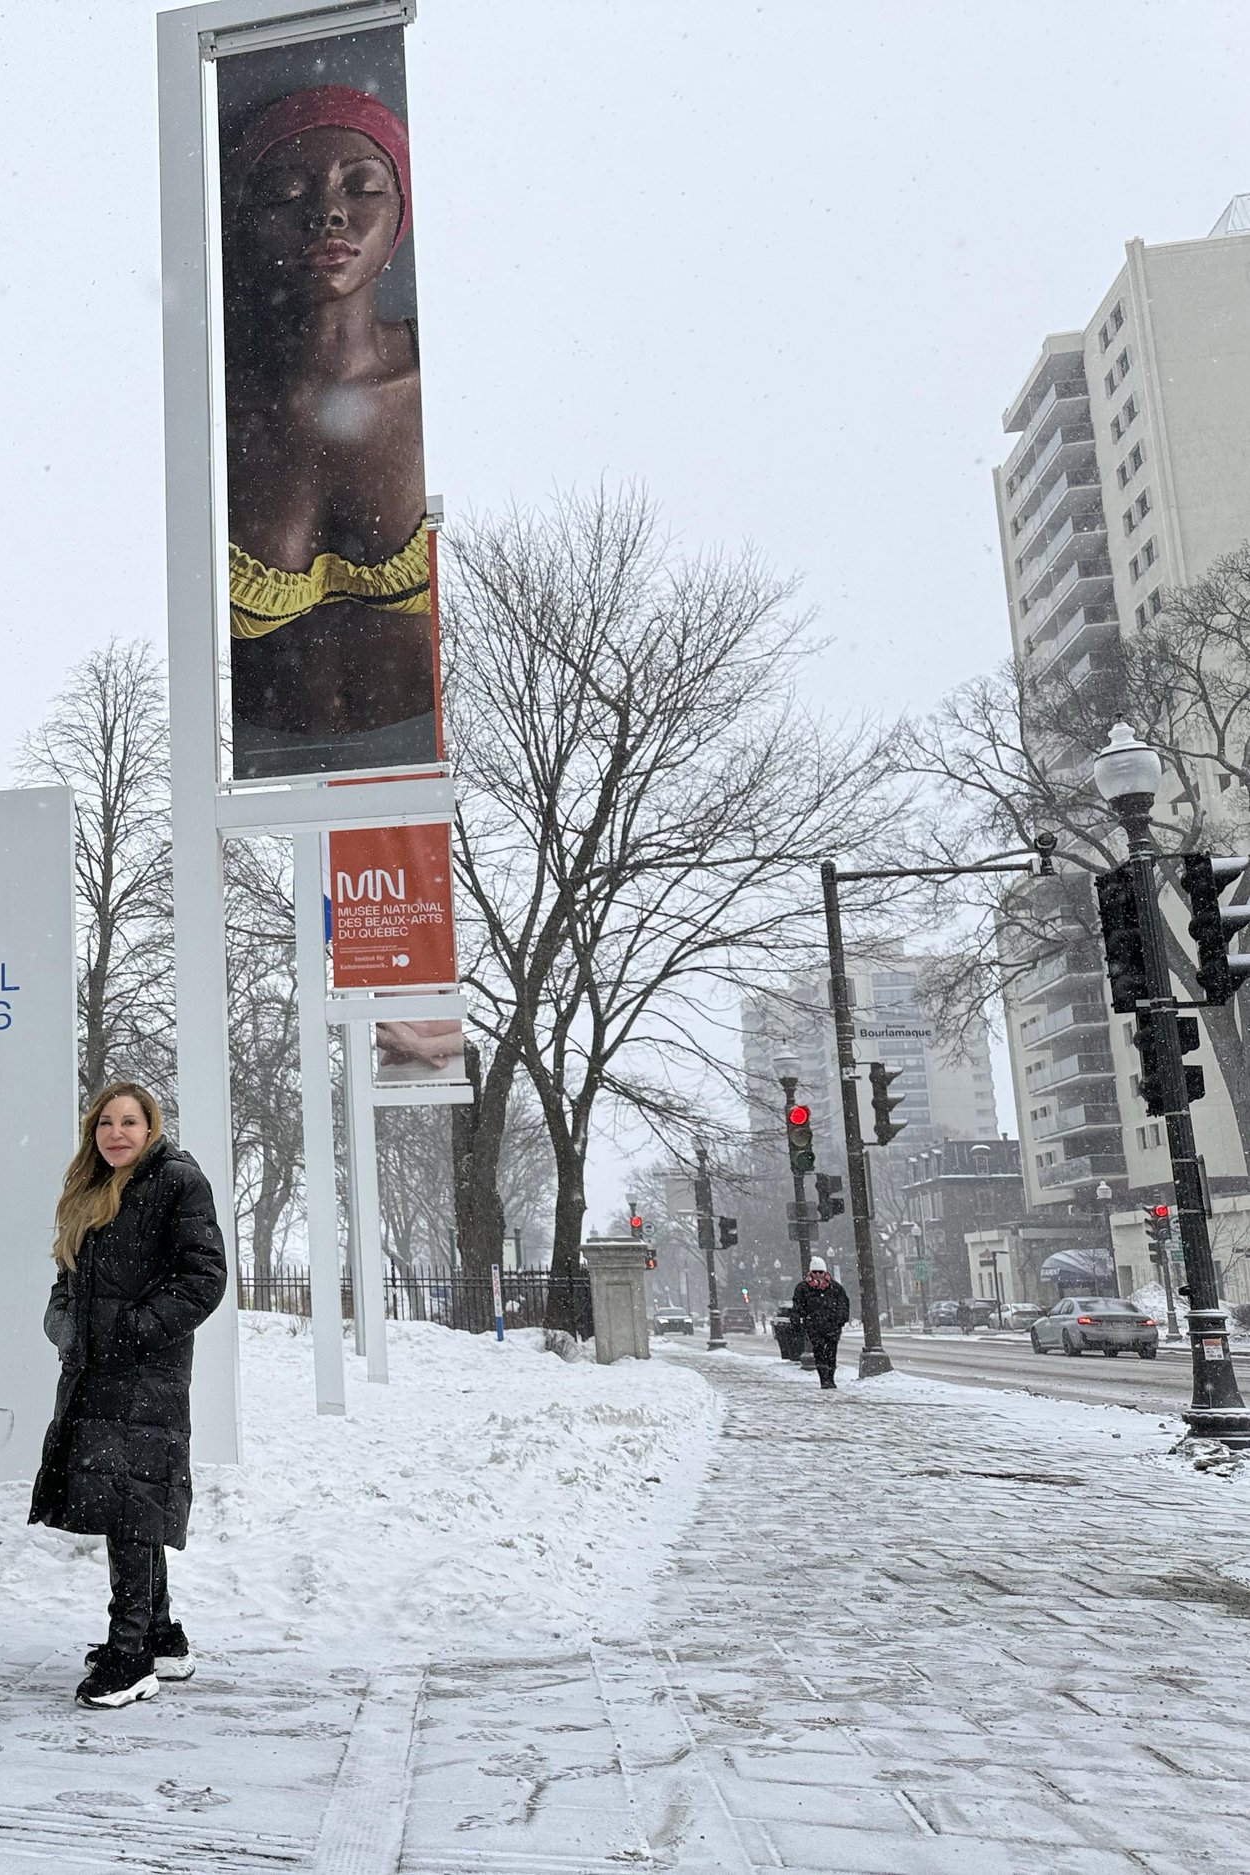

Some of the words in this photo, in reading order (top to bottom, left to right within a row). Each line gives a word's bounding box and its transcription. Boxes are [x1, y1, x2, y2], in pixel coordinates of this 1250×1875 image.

[338, 904, 380, 917] MUSÉE
[383, 902, 445, 915] NATIONAL
[338, 918, 362, 929] DES
[365, 913, 443, 927] BEAUX-ARTS
[338, 929, 356, 939] DU
[359, 926, 409, 938] QUÉBEC
[860, 1029, 931, 1038] Bourlamaque
